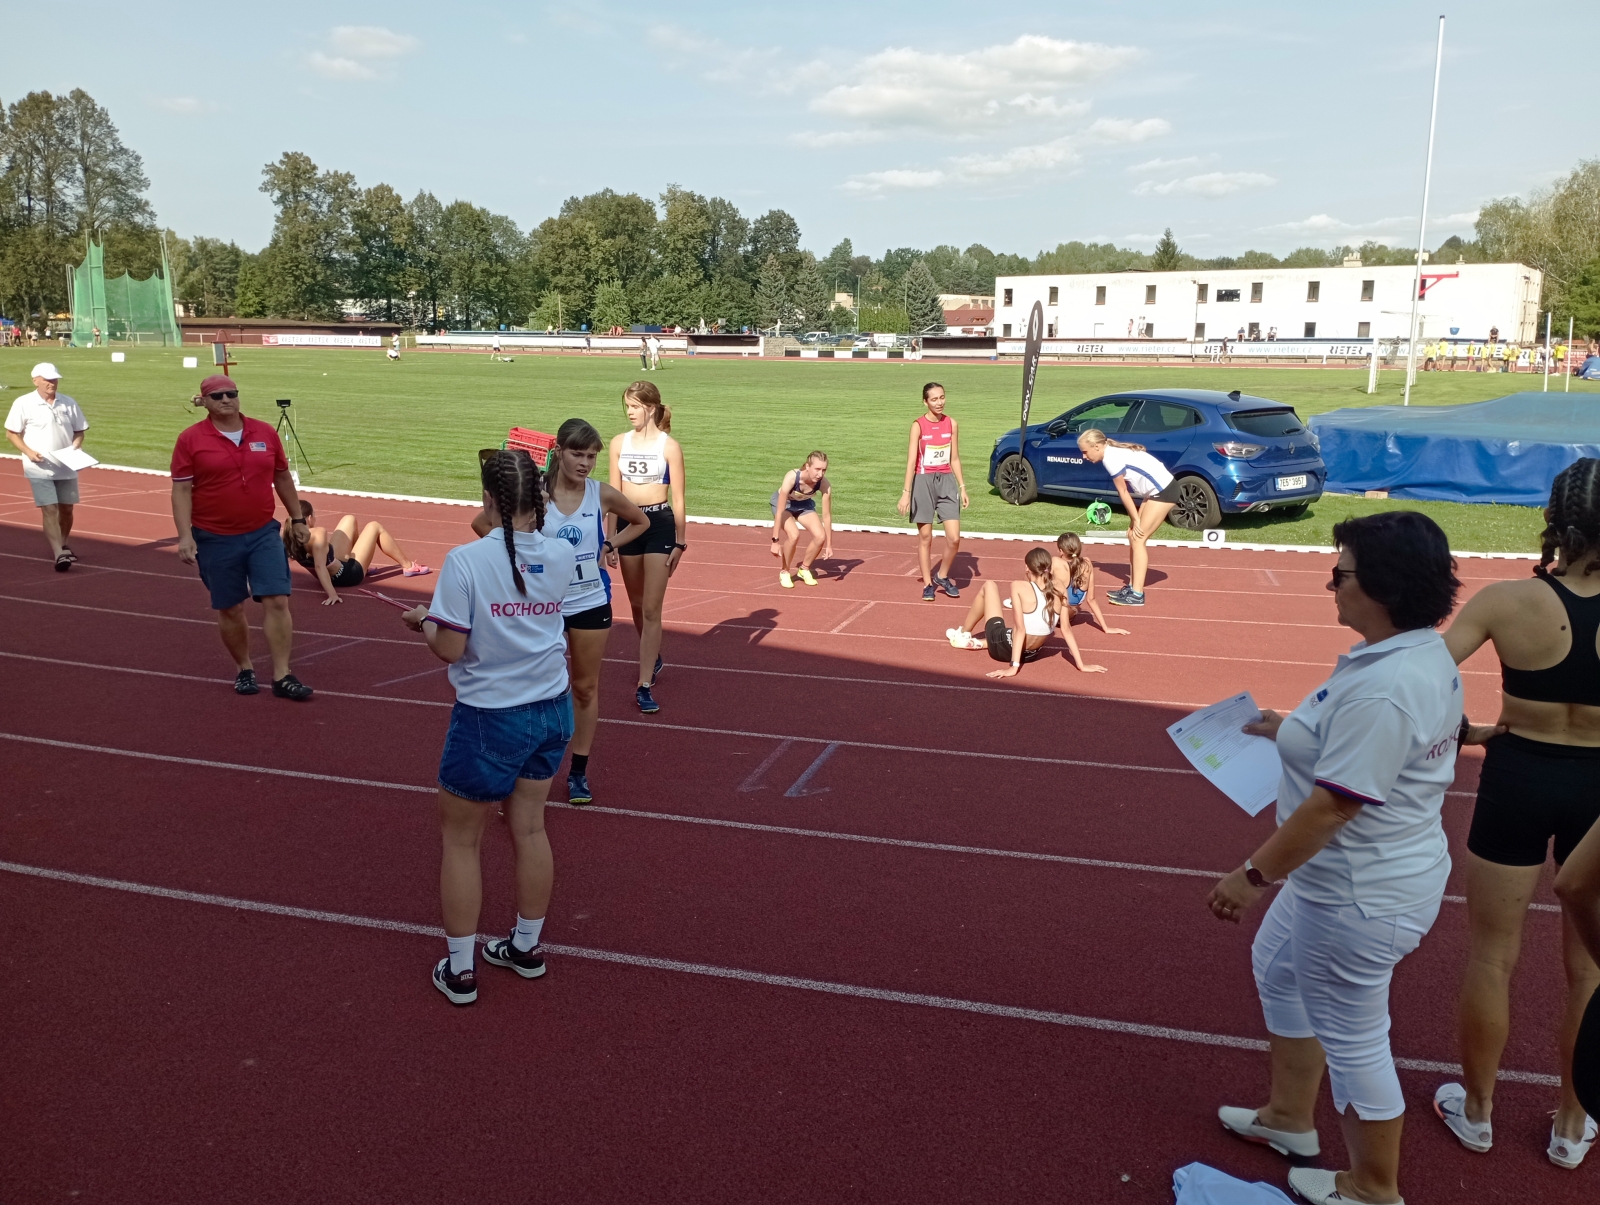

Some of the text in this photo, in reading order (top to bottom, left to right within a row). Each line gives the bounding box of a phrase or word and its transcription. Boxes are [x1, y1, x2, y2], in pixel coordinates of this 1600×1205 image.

[1076, 344, 1104, 353] RIETER
[1118, 345, 1176, 353] www.rieter.cz
[1248, 345, 1312, 354] www.rieter.cz
[1329, 345, 1363, 355] RIETER
[933, 450, 945, 459] 20
[1046, 455, 1083, 465] RENAULT CLIO
[627, 461, 648, 474] 53
